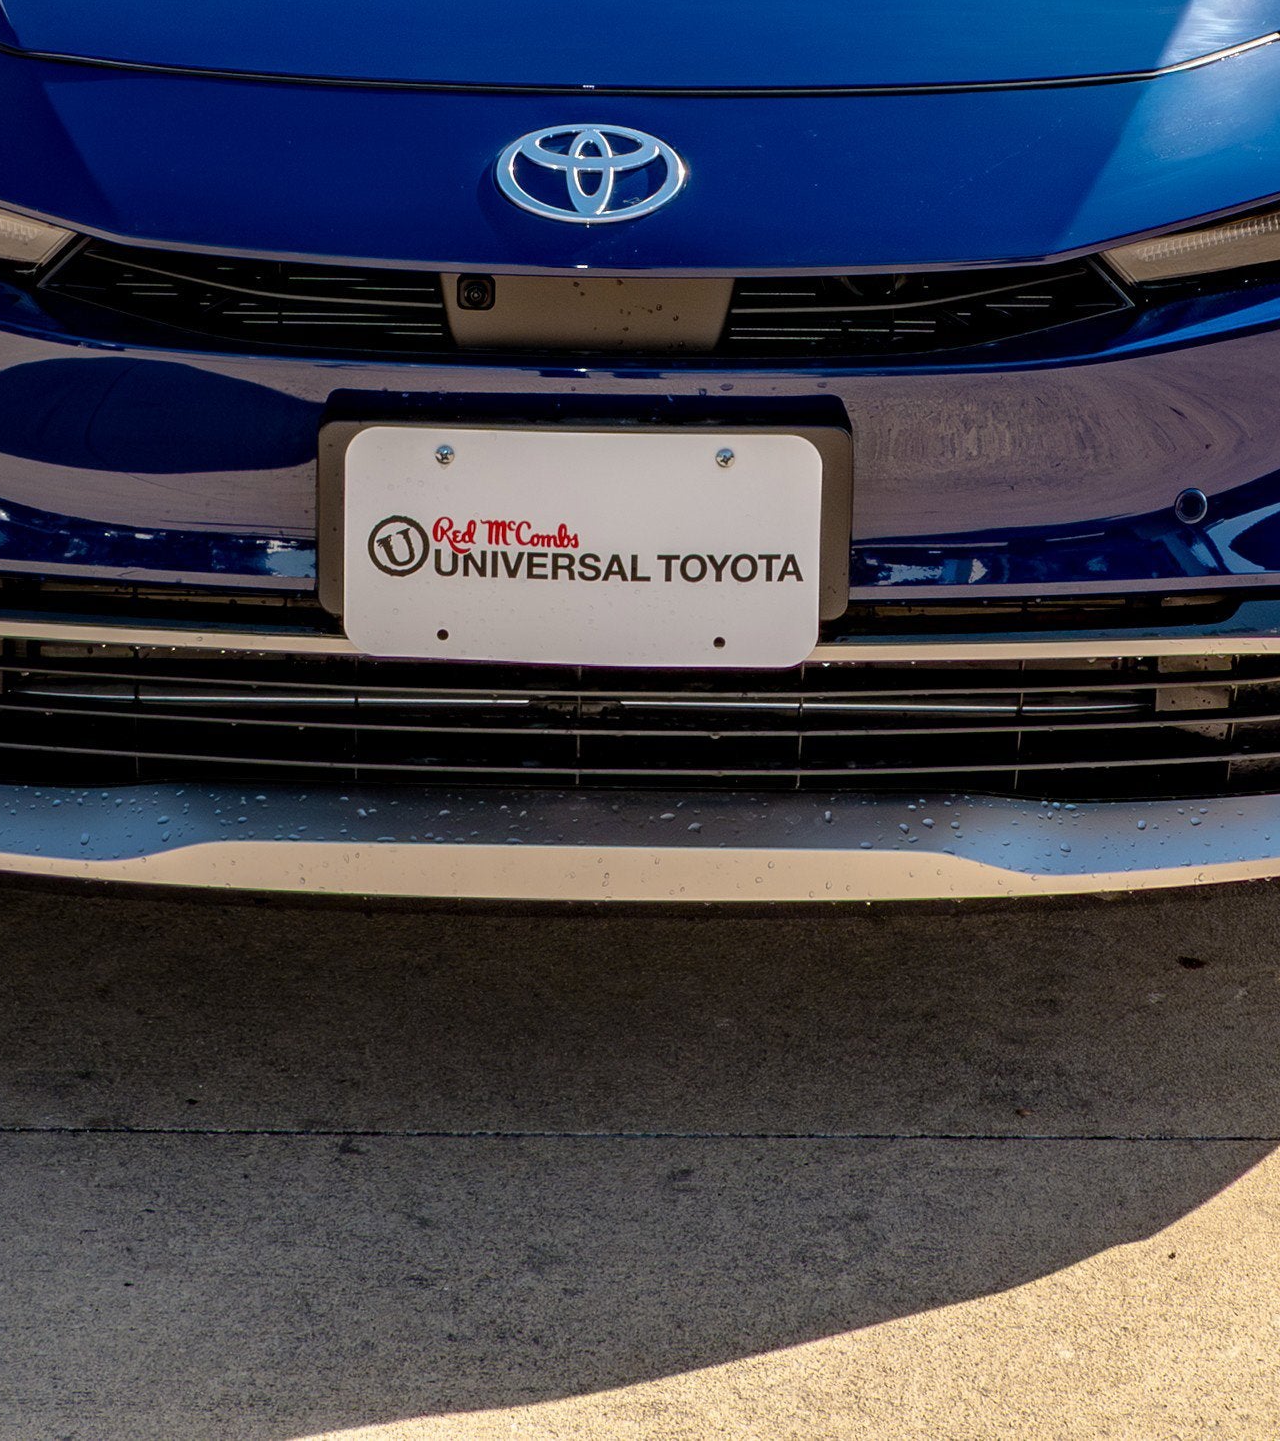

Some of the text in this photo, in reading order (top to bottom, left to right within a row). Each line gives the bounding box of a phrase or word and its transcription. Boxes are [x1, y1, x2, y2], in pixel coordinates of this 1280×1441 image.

[432, 515, 580, 555] Red McCombs
[433, 548, 805, 584] UNIVERSAL TOYOTA
